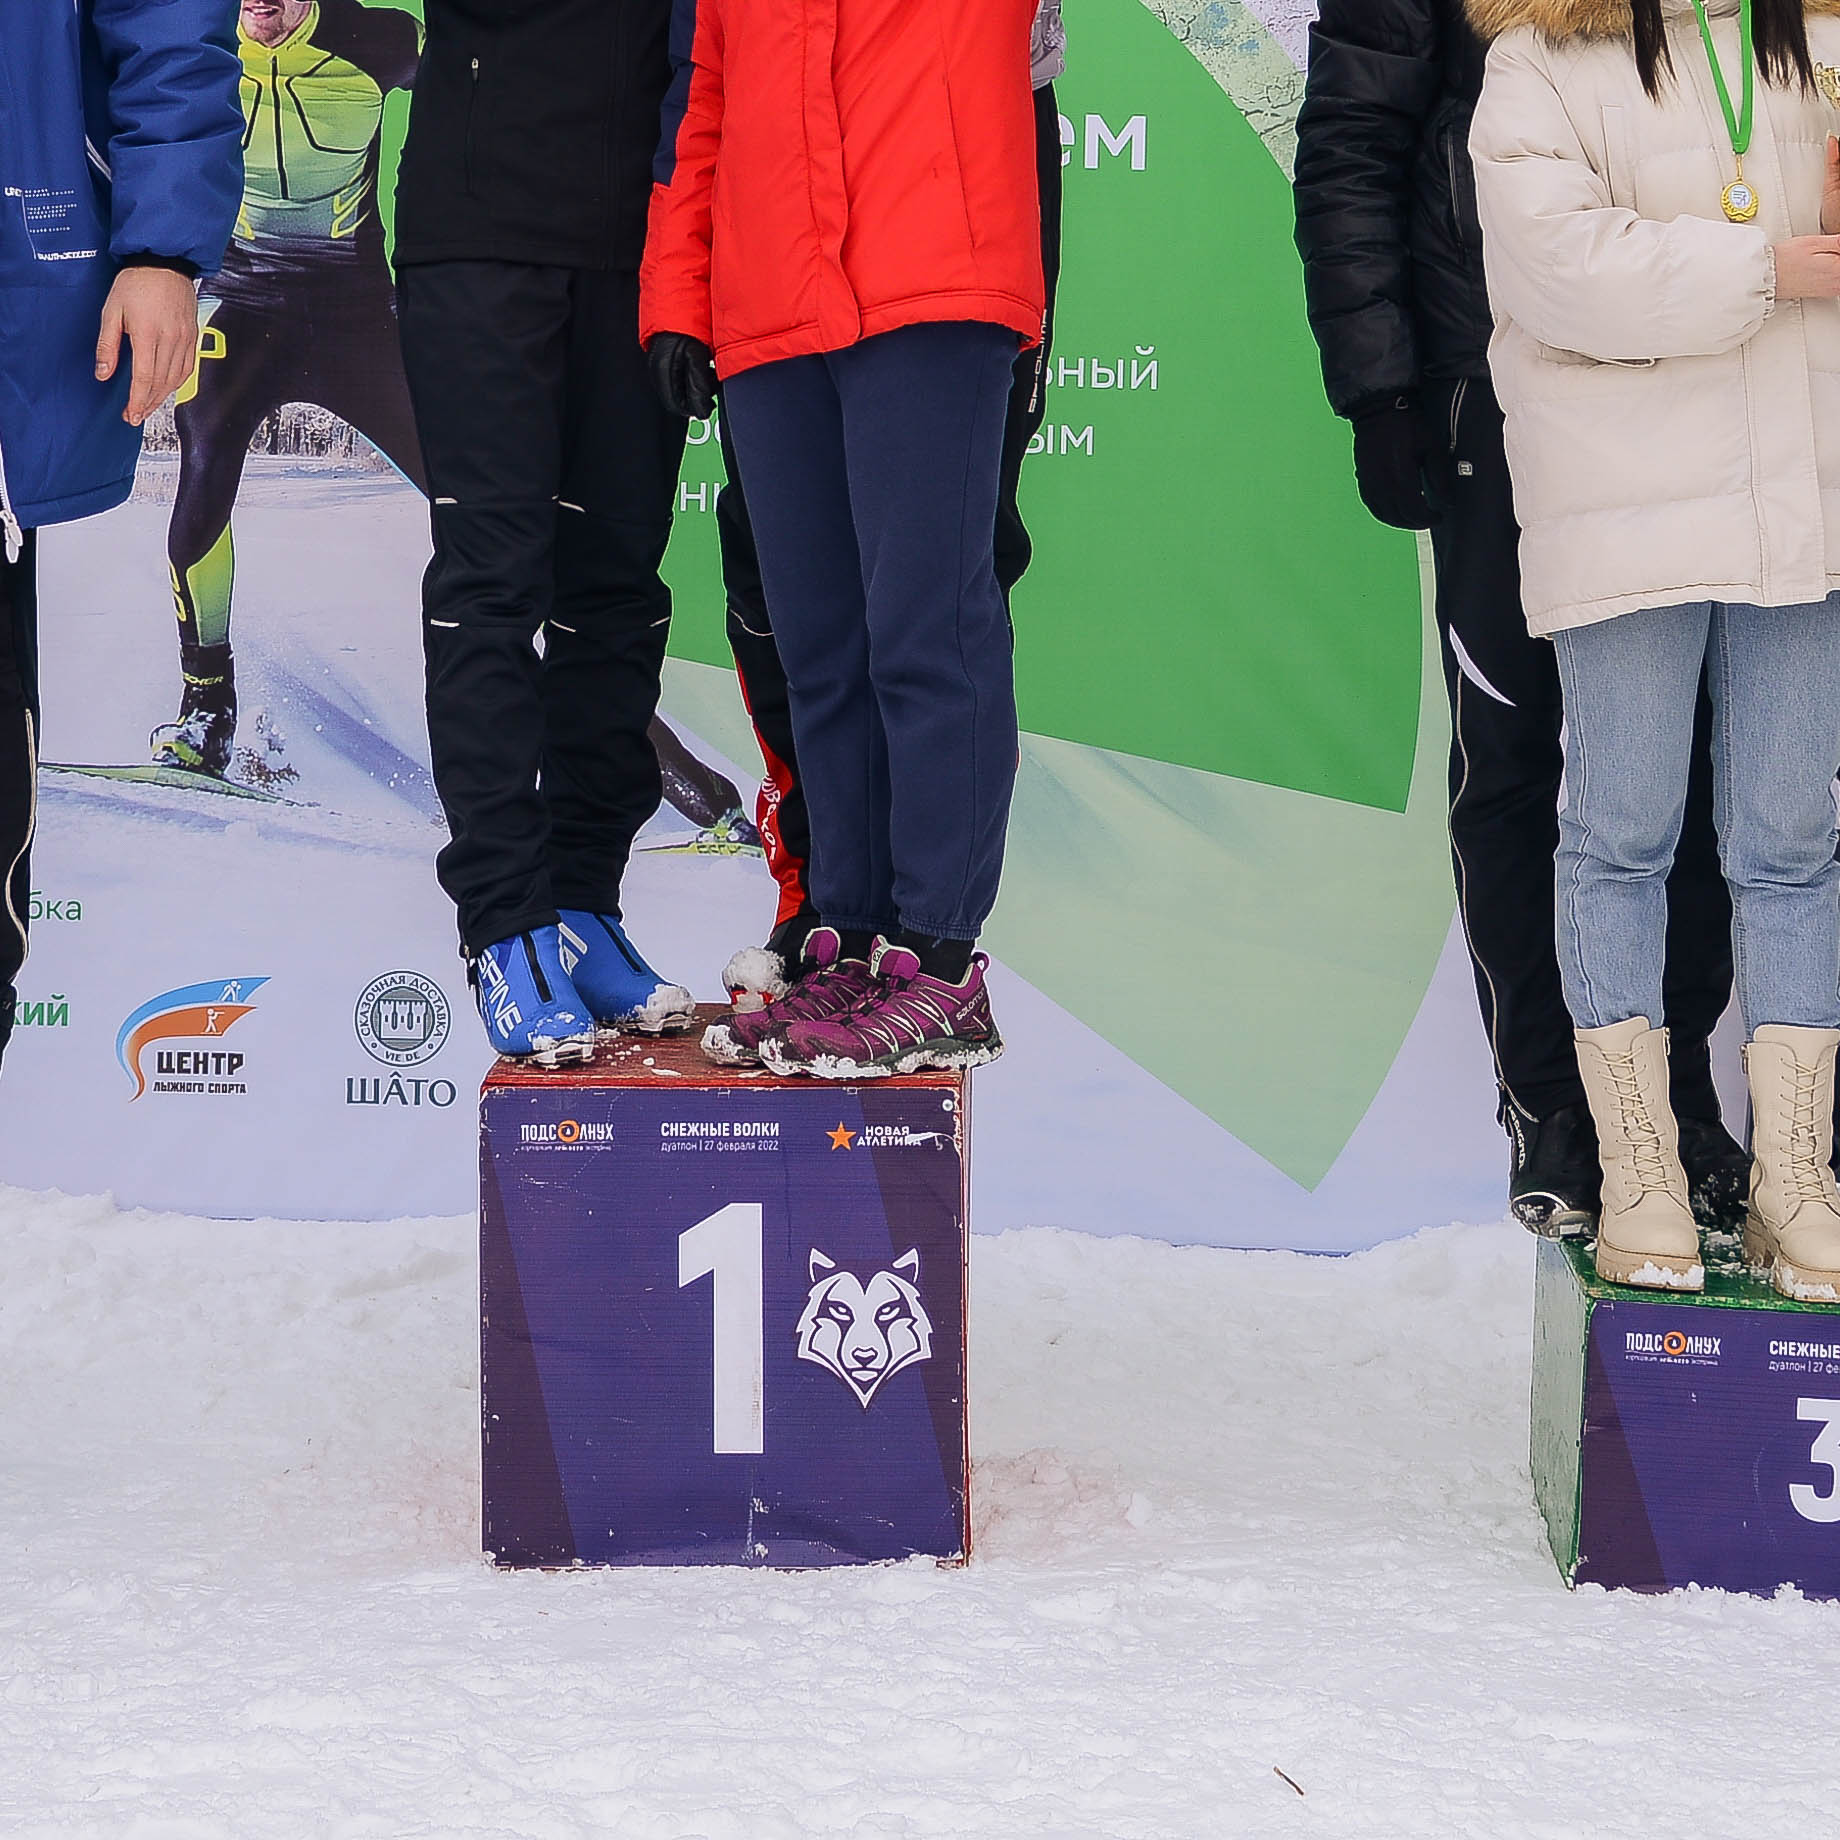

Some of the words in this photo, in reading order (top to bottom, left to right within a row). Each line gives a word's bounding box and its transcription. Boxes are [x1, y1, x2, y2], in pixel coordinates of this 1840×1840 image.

[478, 950, 522, 1039] SPINE
[359, 975, 406, 1037] СКАЗОЧНАЯ
[409, 977, 447, 1038] ДОСТАВКА
[157, 1051, 244, 1075] ЦЕНТР
[384, 1051, 401, 1062] VIE
[153, 1081, 204, 1093] ЛЫЖНОГО
[207, 1082, 247, 1094] СПОРТА
[661, 1122, 730, 1137] СНЕЖНЫЕ
[733, 1122, 780, 1137] ВОЛКИ
[865, 1126, 910, 1136] НОВАЯ
[661, 1141, 697, 1152] дуатлон
[705, 1140, 714, 1151] 27
[716, 1140, 755, 1152] февраля
[757, 1140, 779, 1151] 2022
[678, 1202, 764, 1455] 1
[1769, 1340, 1840, 1359] СНЕЖНЫЕ
[1768, 1361, 1805, 1372] дуатлон
[1813, 1362, 1823, 1373] 27
